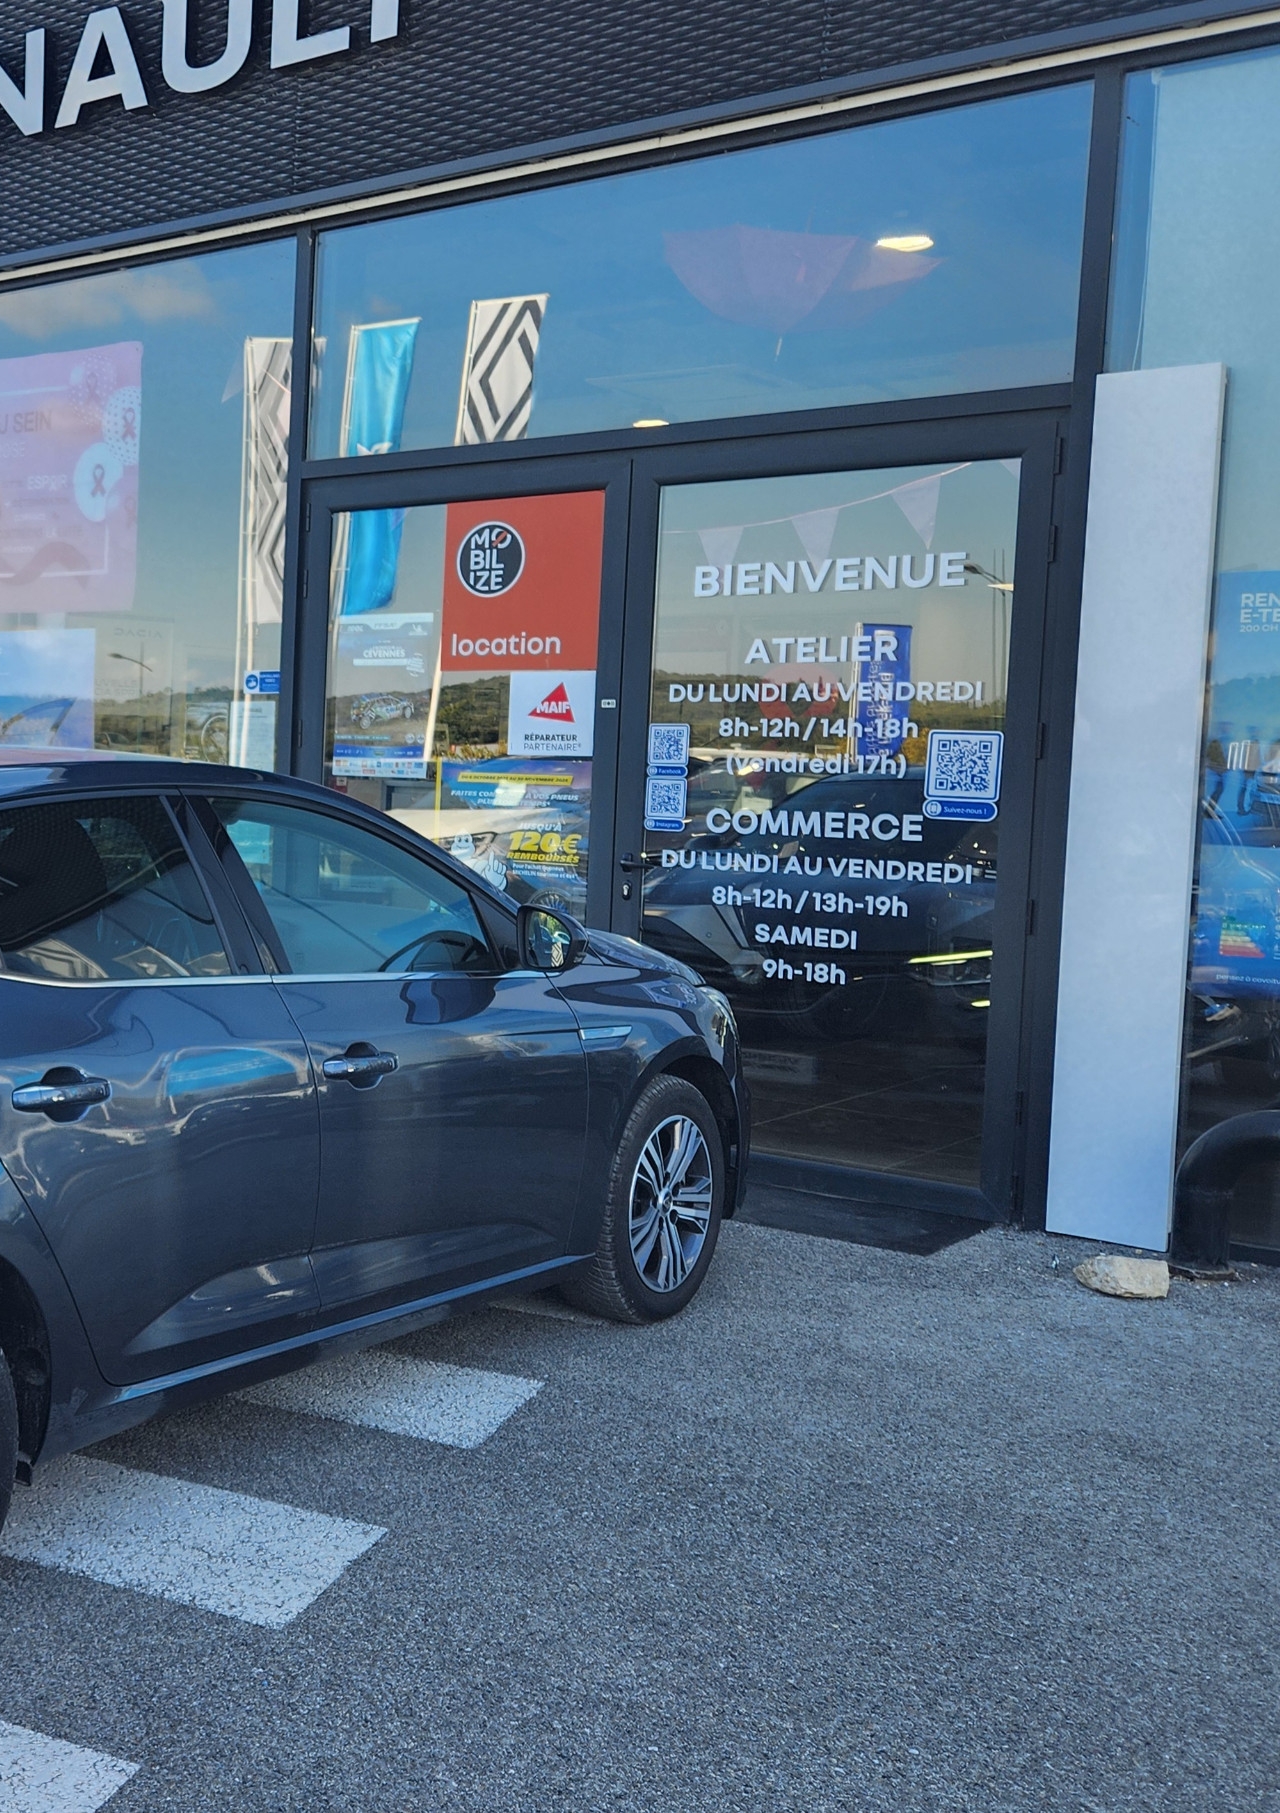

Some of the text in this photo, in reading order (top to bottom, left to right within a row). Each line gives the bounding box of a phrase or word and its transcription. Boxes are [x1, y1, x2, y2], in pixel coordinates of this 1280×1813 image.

[13, 410, 52, 433] SEIN
[470, 548, 505, 570] BIL
[470, 569, 504, 591] IZE
[694, 552, 967, 597] BIENVENUE
[451, 631, 561, 656] location
[745, 635, 899, 665] ATELIER
[670, 681, 982, 702] DU LUNDI AU VENDREDI
[536, 701, 570, 714] MAIF
[524, 732, 578, 742] RÉPARATEUR
[719, 717, 800, 738] 8h-12h
[820, 717, 919, 739] 14h-18h
[726, 754, 907, 778] (vendredi 17h)
[942, 804, 982, 816] Suivez-nous
[706, 808, 924, 841] COMMERCE
[509, 831, 582, 854] 120€
[506, 851, 580, 863] REMBOURSÉS
[661, 849, 972, 884] DU LUNDI AU VENDREDI
[712, 886, 792, 910] 8h-12h
[813, 892, 909, 918] 13h-19h
[755, 924, 857, 950] SAMEDI
[762, 958, 846, 985] 9h-18h
